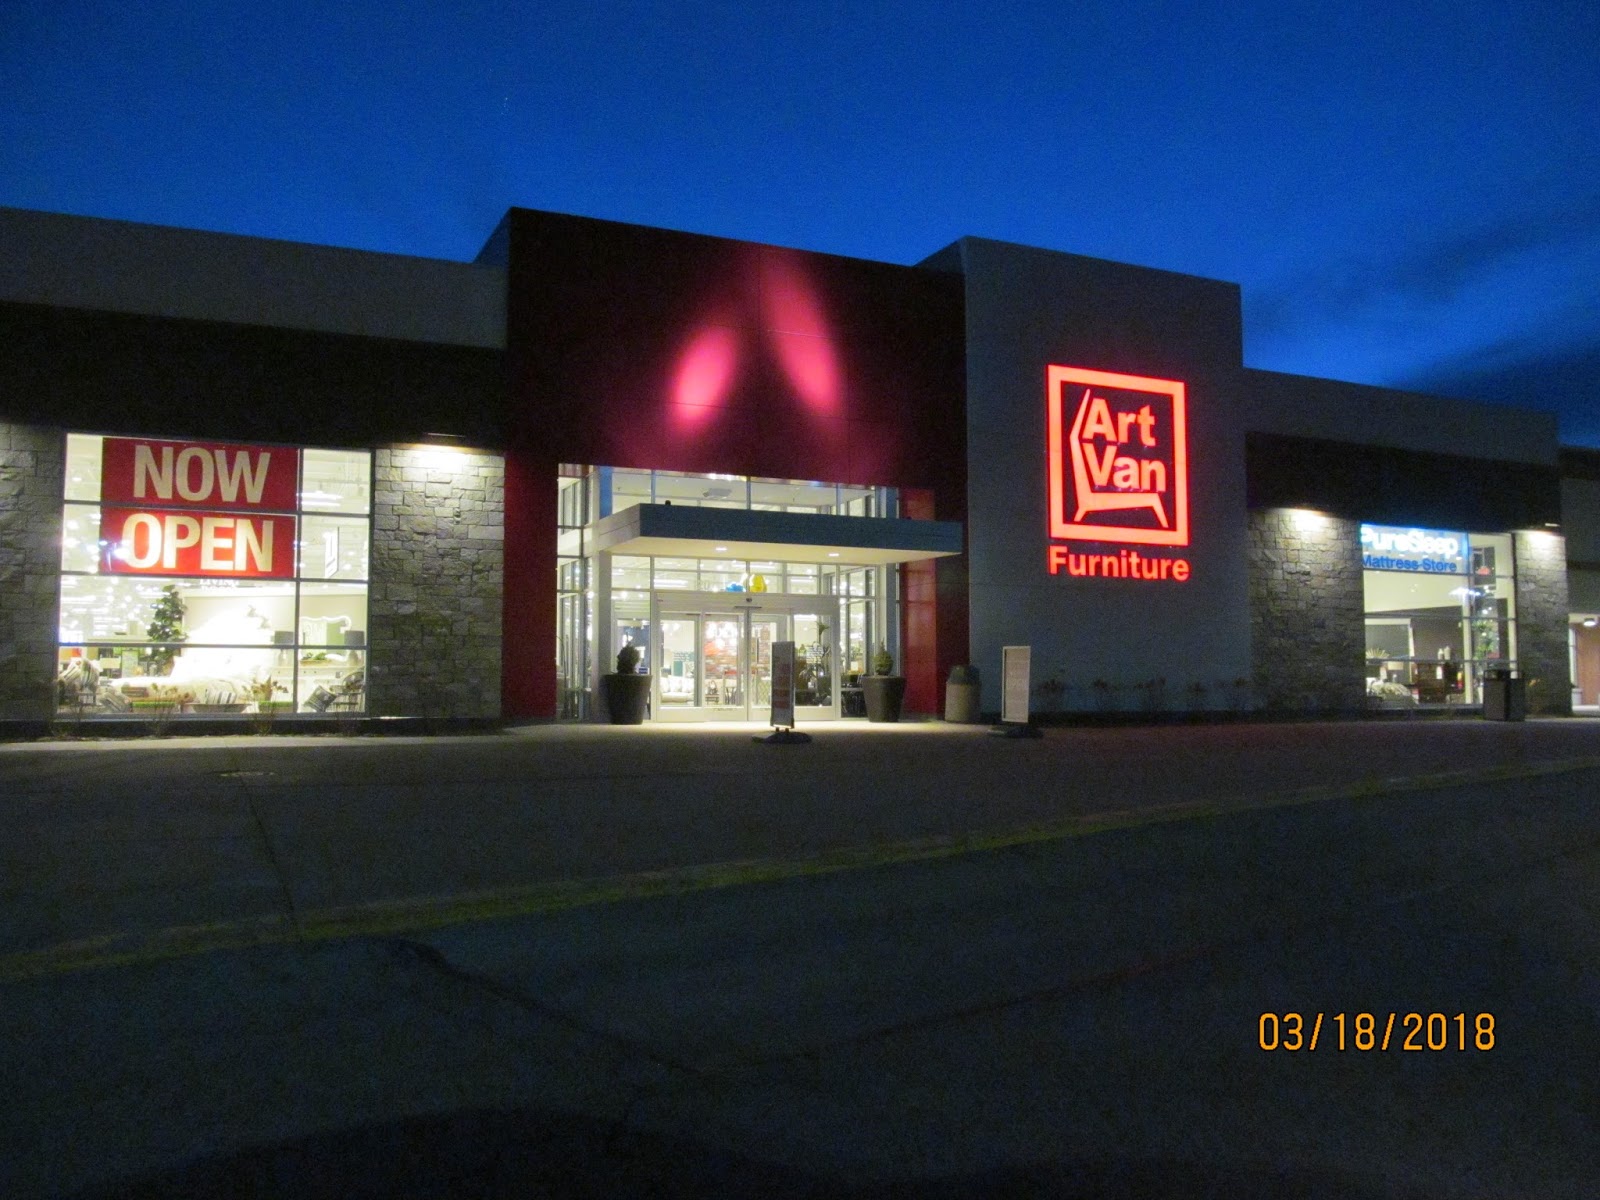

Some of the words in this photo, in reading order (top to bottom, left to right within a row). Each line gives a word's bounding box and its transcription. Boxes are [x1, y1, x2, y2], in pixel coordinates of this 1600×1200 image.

[1082, 398, 1156, 447] Art
[133, 445, 271, 503] NOW
[1082, 442, 1167, 492] Van
[122, 513, 274, 572] OPEN
[1049, 545, 1191, 582] Furniture
[1362, 555, 1420, 570] Mattress
[1422, 558, 1456, 572] Store
